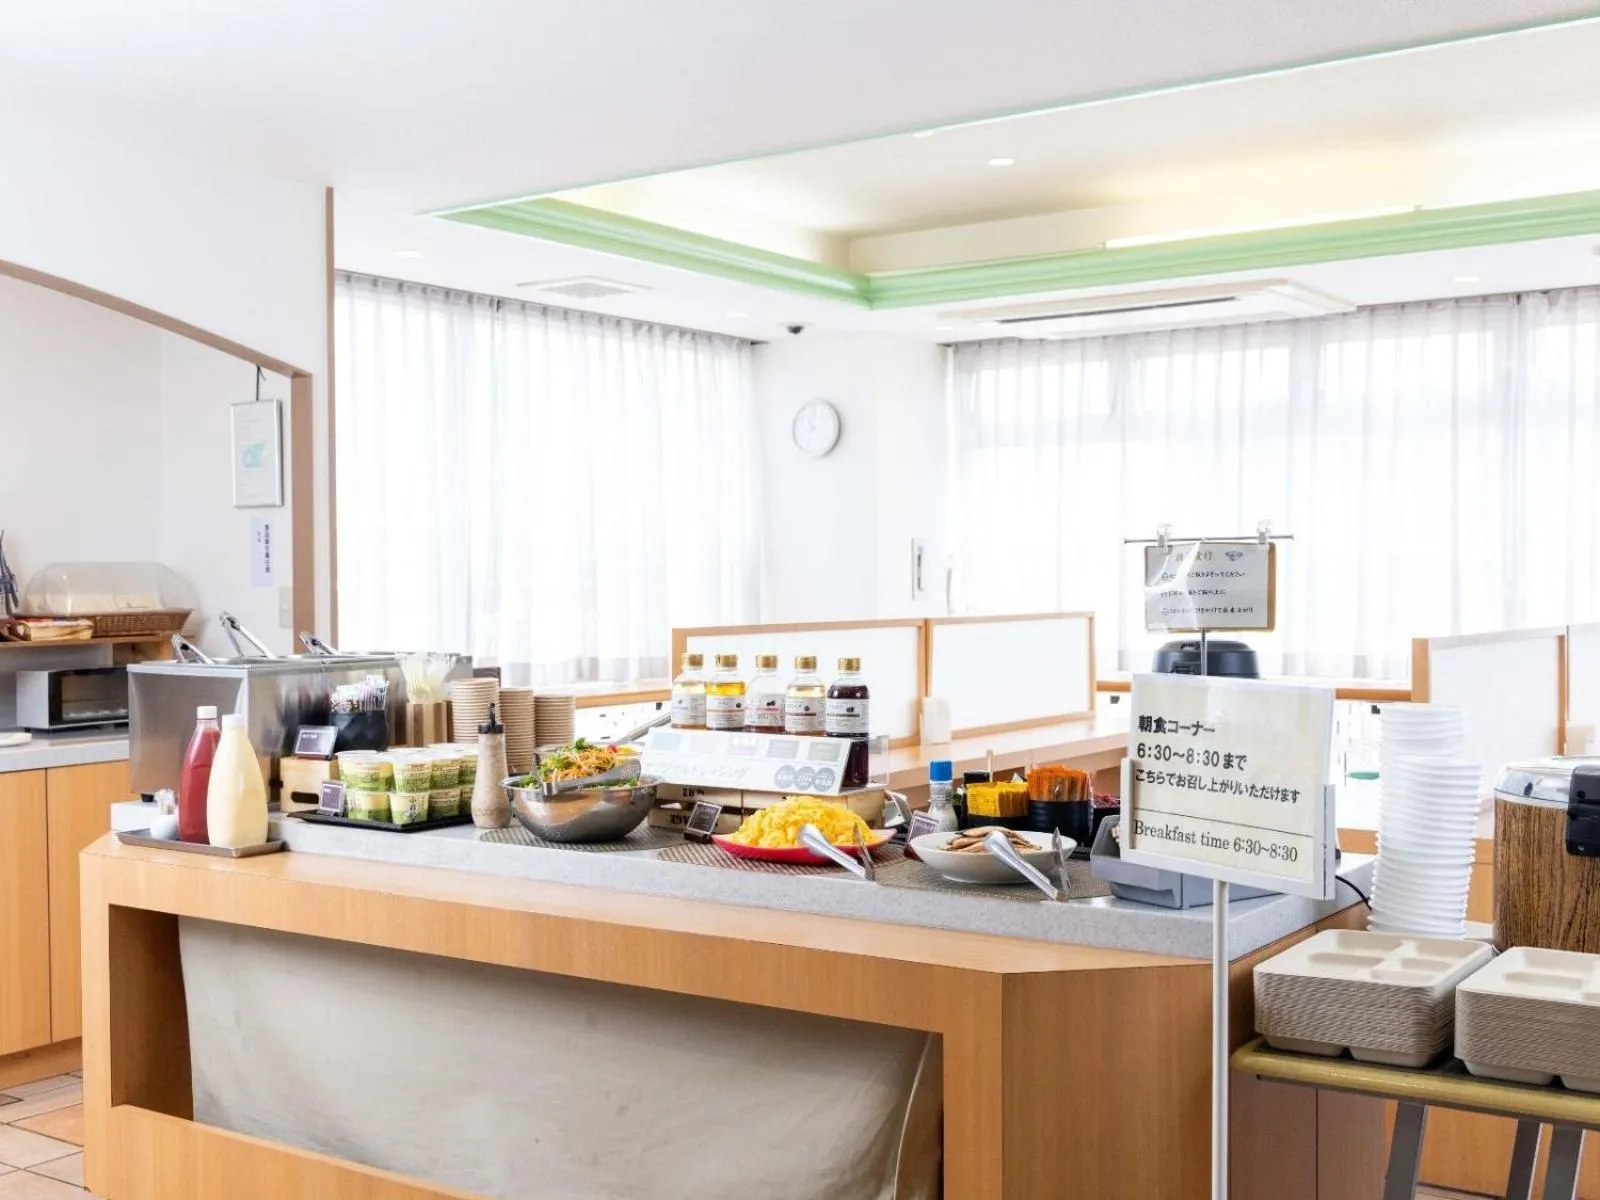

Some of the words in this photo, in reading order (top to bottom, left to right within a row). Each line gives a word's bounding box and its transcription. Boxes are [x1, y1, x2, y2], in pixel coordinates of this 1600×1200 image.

[1138, 714, 1215, 736] 朝食コーナー
[1135, 768, 1300, 804] こちらでお召し上がりいただけます
[1134, 820, 1196, 845] Breakfast
[1201, 832, 1229, 850] time
